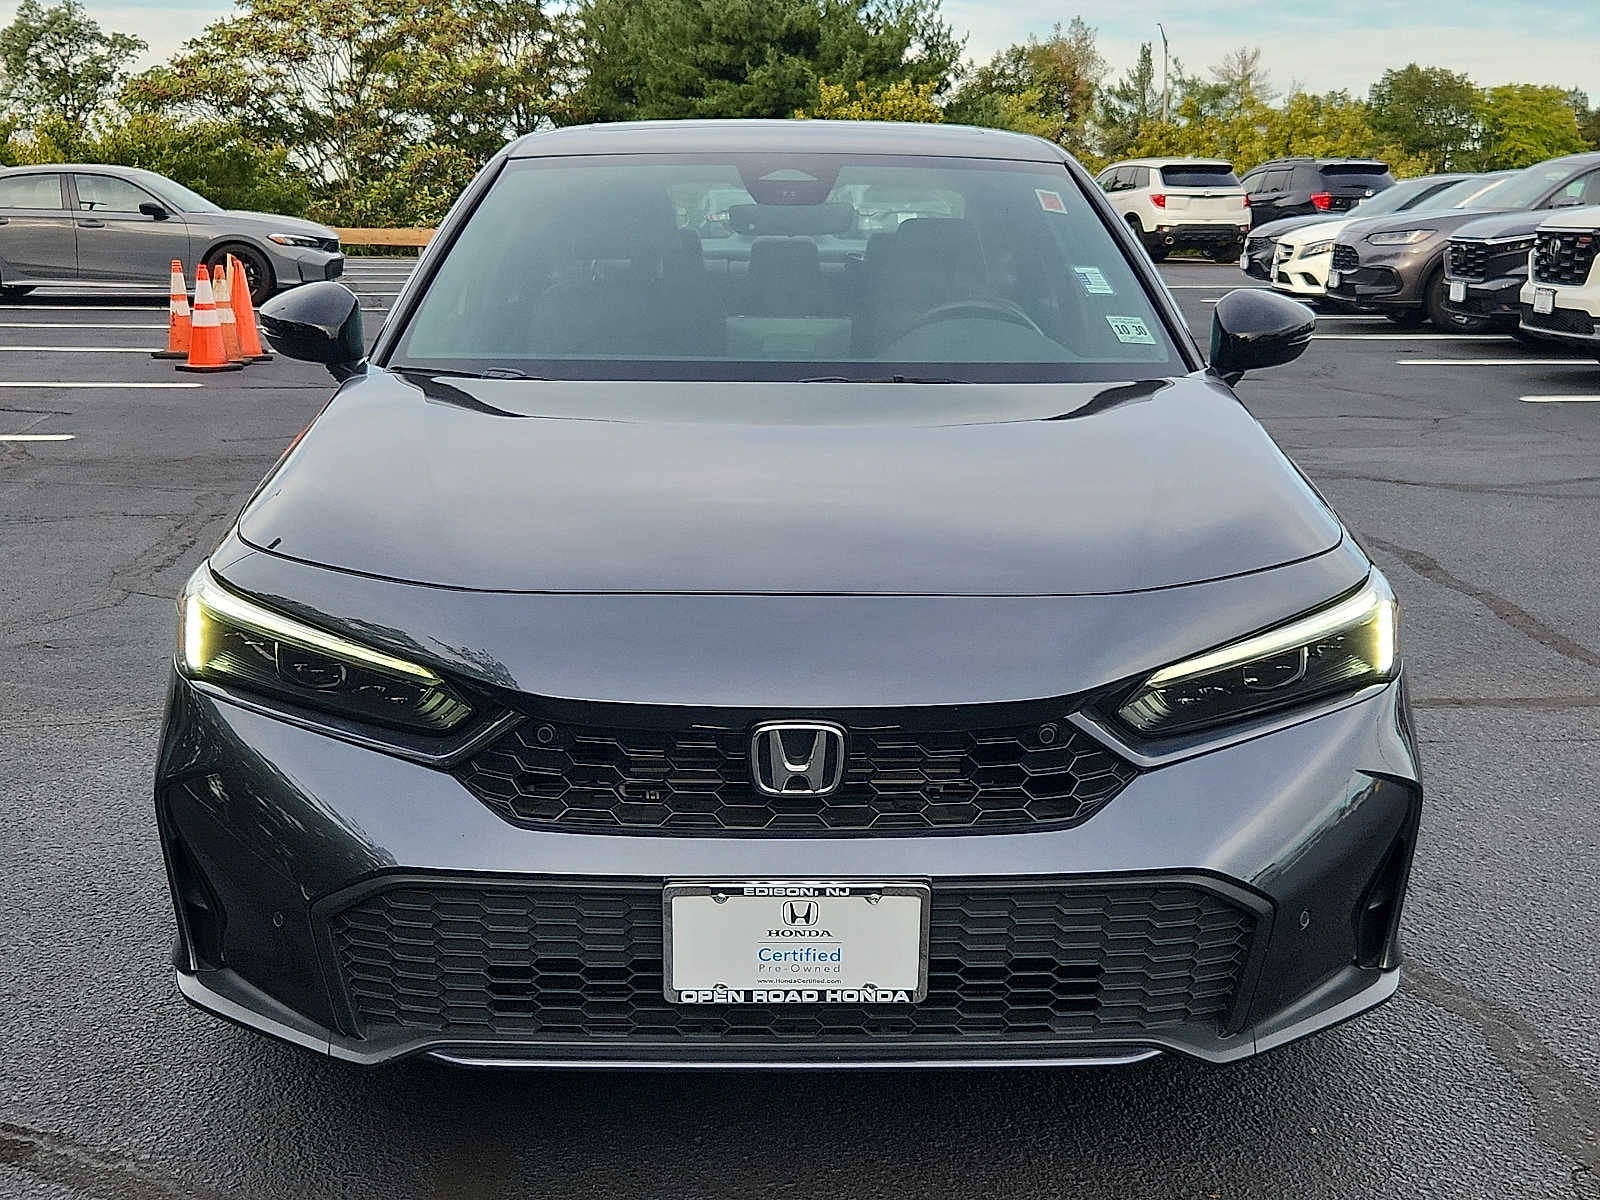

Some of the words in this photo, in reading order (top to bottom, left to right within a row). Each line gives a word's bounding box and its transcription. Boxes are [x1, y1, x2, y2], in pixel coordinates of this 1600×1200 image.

[1115, 324, 1130, 335] 10
[743, 887, 820, 897] EDISON,
[825, 887, 850, 896] NJ
[766, 929, 834, 938] HONDA
[758, 947, 841, 962] Certified
[758, 963, 841, 973] Pre-Owned
[680, 990, 745, 1003] OPEN
[752, 990, 819, 1003] ROAD
[826, 990, 911, 1003] HONDA
